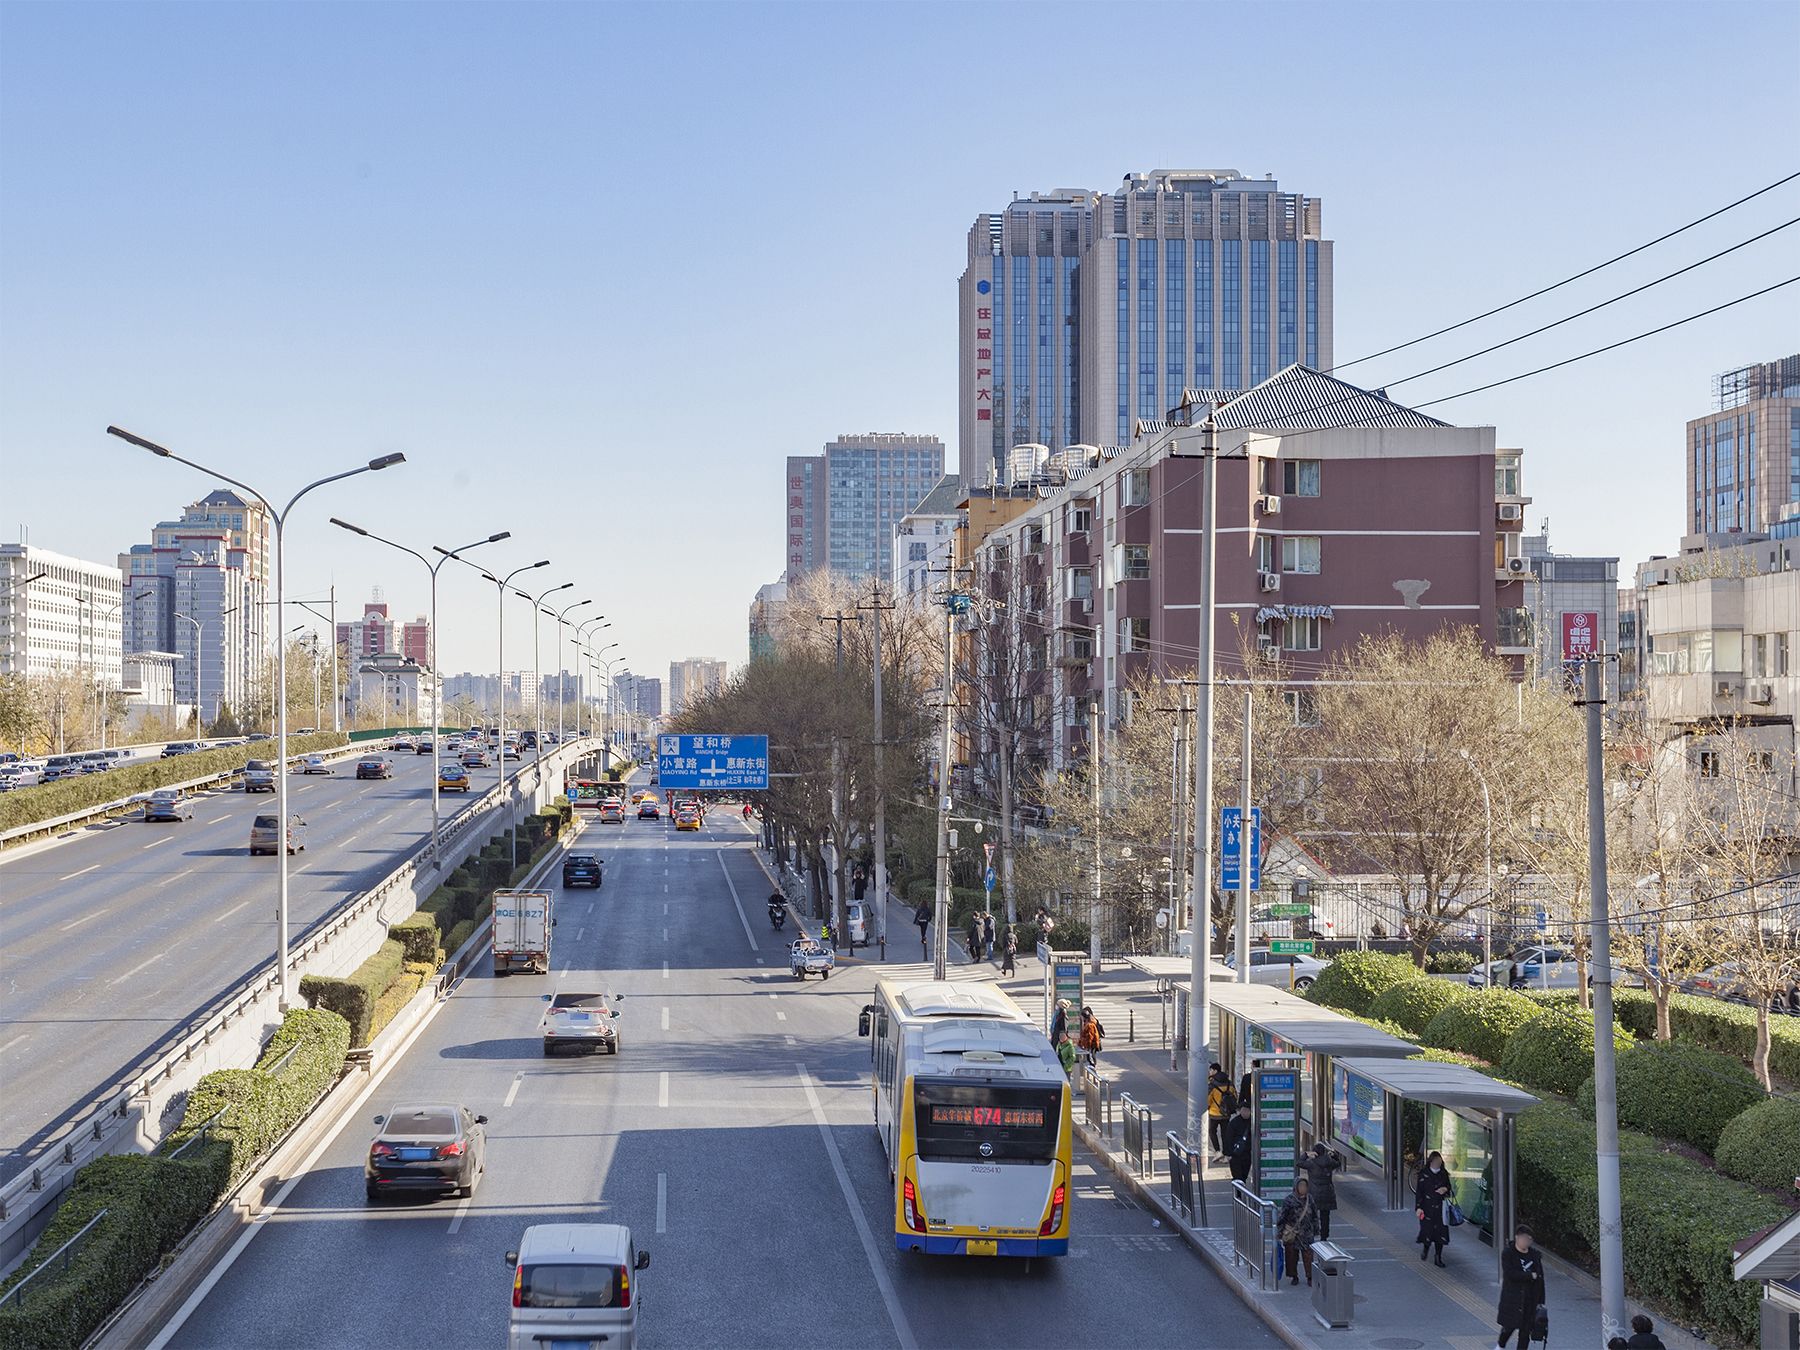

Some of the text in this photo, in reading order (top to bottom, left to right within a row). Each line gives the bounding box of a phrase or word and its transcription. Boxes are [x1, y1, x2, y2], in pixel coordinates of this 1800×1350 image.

[789, 476, 804, 586] 世奥国际中心
[692, 737, 732, 749] 望和桥
[661, 757, 697, 769] 小营路
[726, 757, 766, 770] 惠新东街
[699, 778, 727, 787] 惠新东桥
[973, 1106, 1001, 1126] 674
